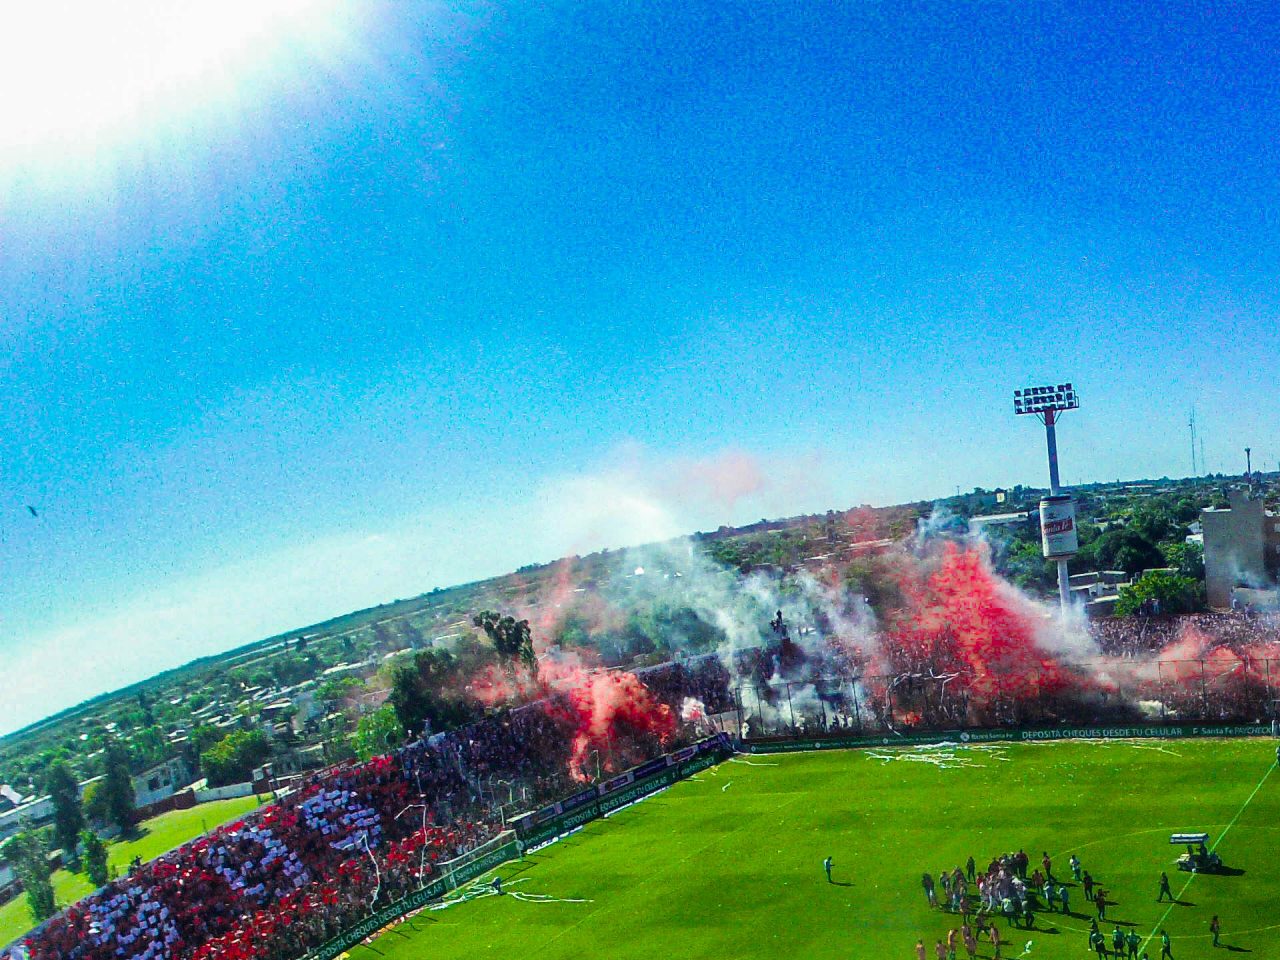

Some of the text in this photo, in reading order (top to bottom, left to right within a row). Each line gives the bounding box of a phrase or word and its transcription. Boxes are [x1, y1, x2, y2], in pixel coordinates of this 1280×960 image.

[1063, 728, 1101, 738] CHEQUES
[1103, 728, 1131, 737] DESDE
[1131, 728, 1142, 737] TU
[1145, 727, 1183, 736] CELULAR
[1201, 727, 1224, 735] Santa
[1225, 727, 1233, 735] Fe
[347, 919, 379, 944] CHEQUES
[378, 906, 403, 924] DESDE
[402, 901, 412, 911] TU
